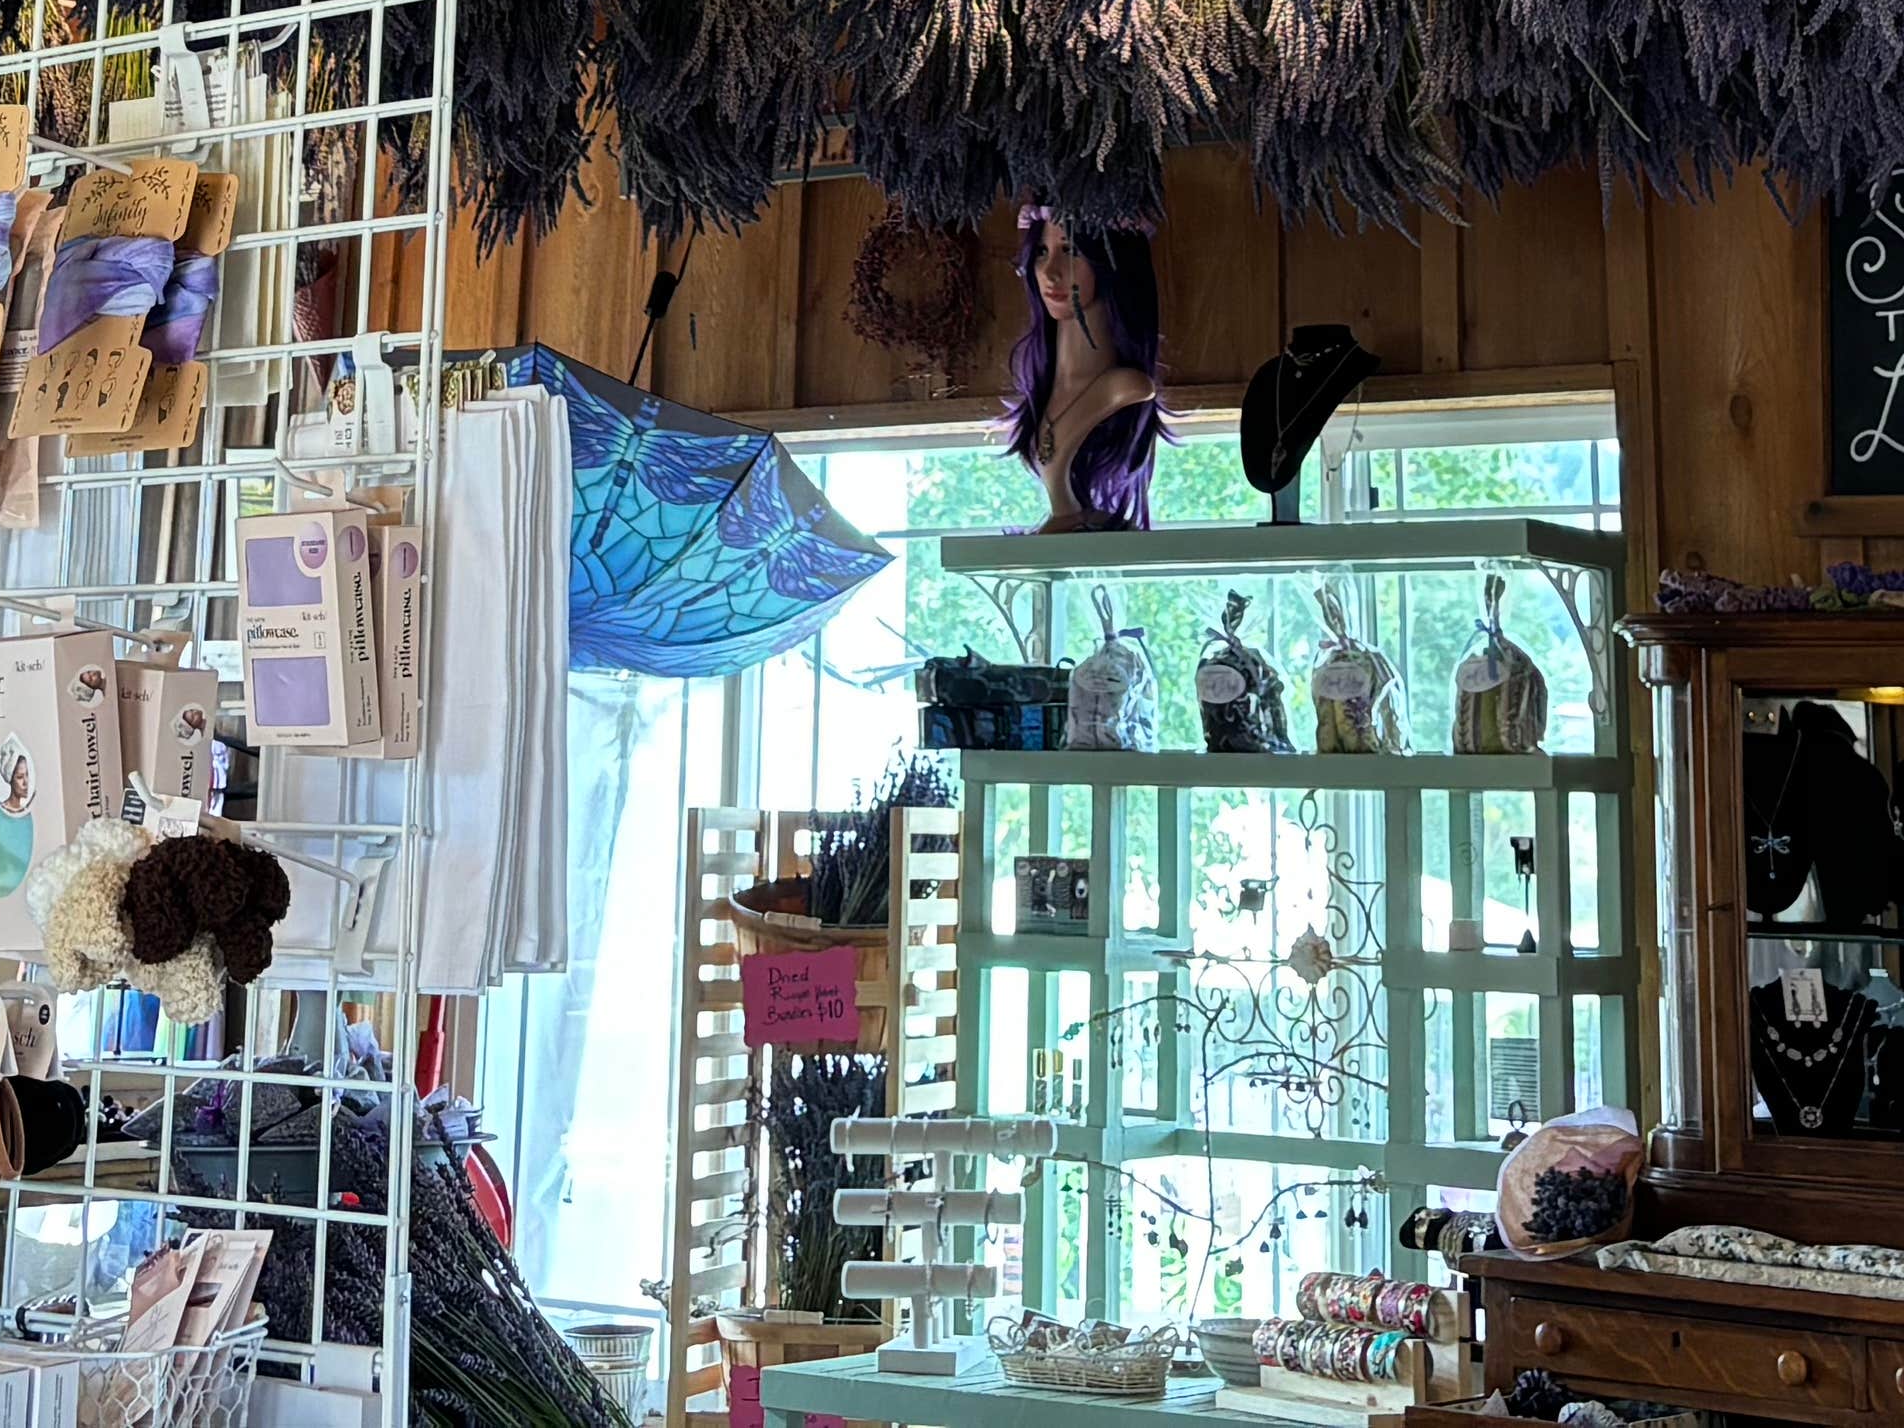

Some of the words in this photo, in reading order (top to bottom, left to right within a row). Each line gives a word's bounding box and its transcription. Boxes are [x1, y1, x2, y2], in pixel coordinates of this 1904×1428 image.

[80, 711, 97, 763] towel.
[85, 765, 101, 811] hair
[181, 750, 194, 797] owel.
[768, 966, 809, 985] Dried
[817, 999, 844, 1022] $10
